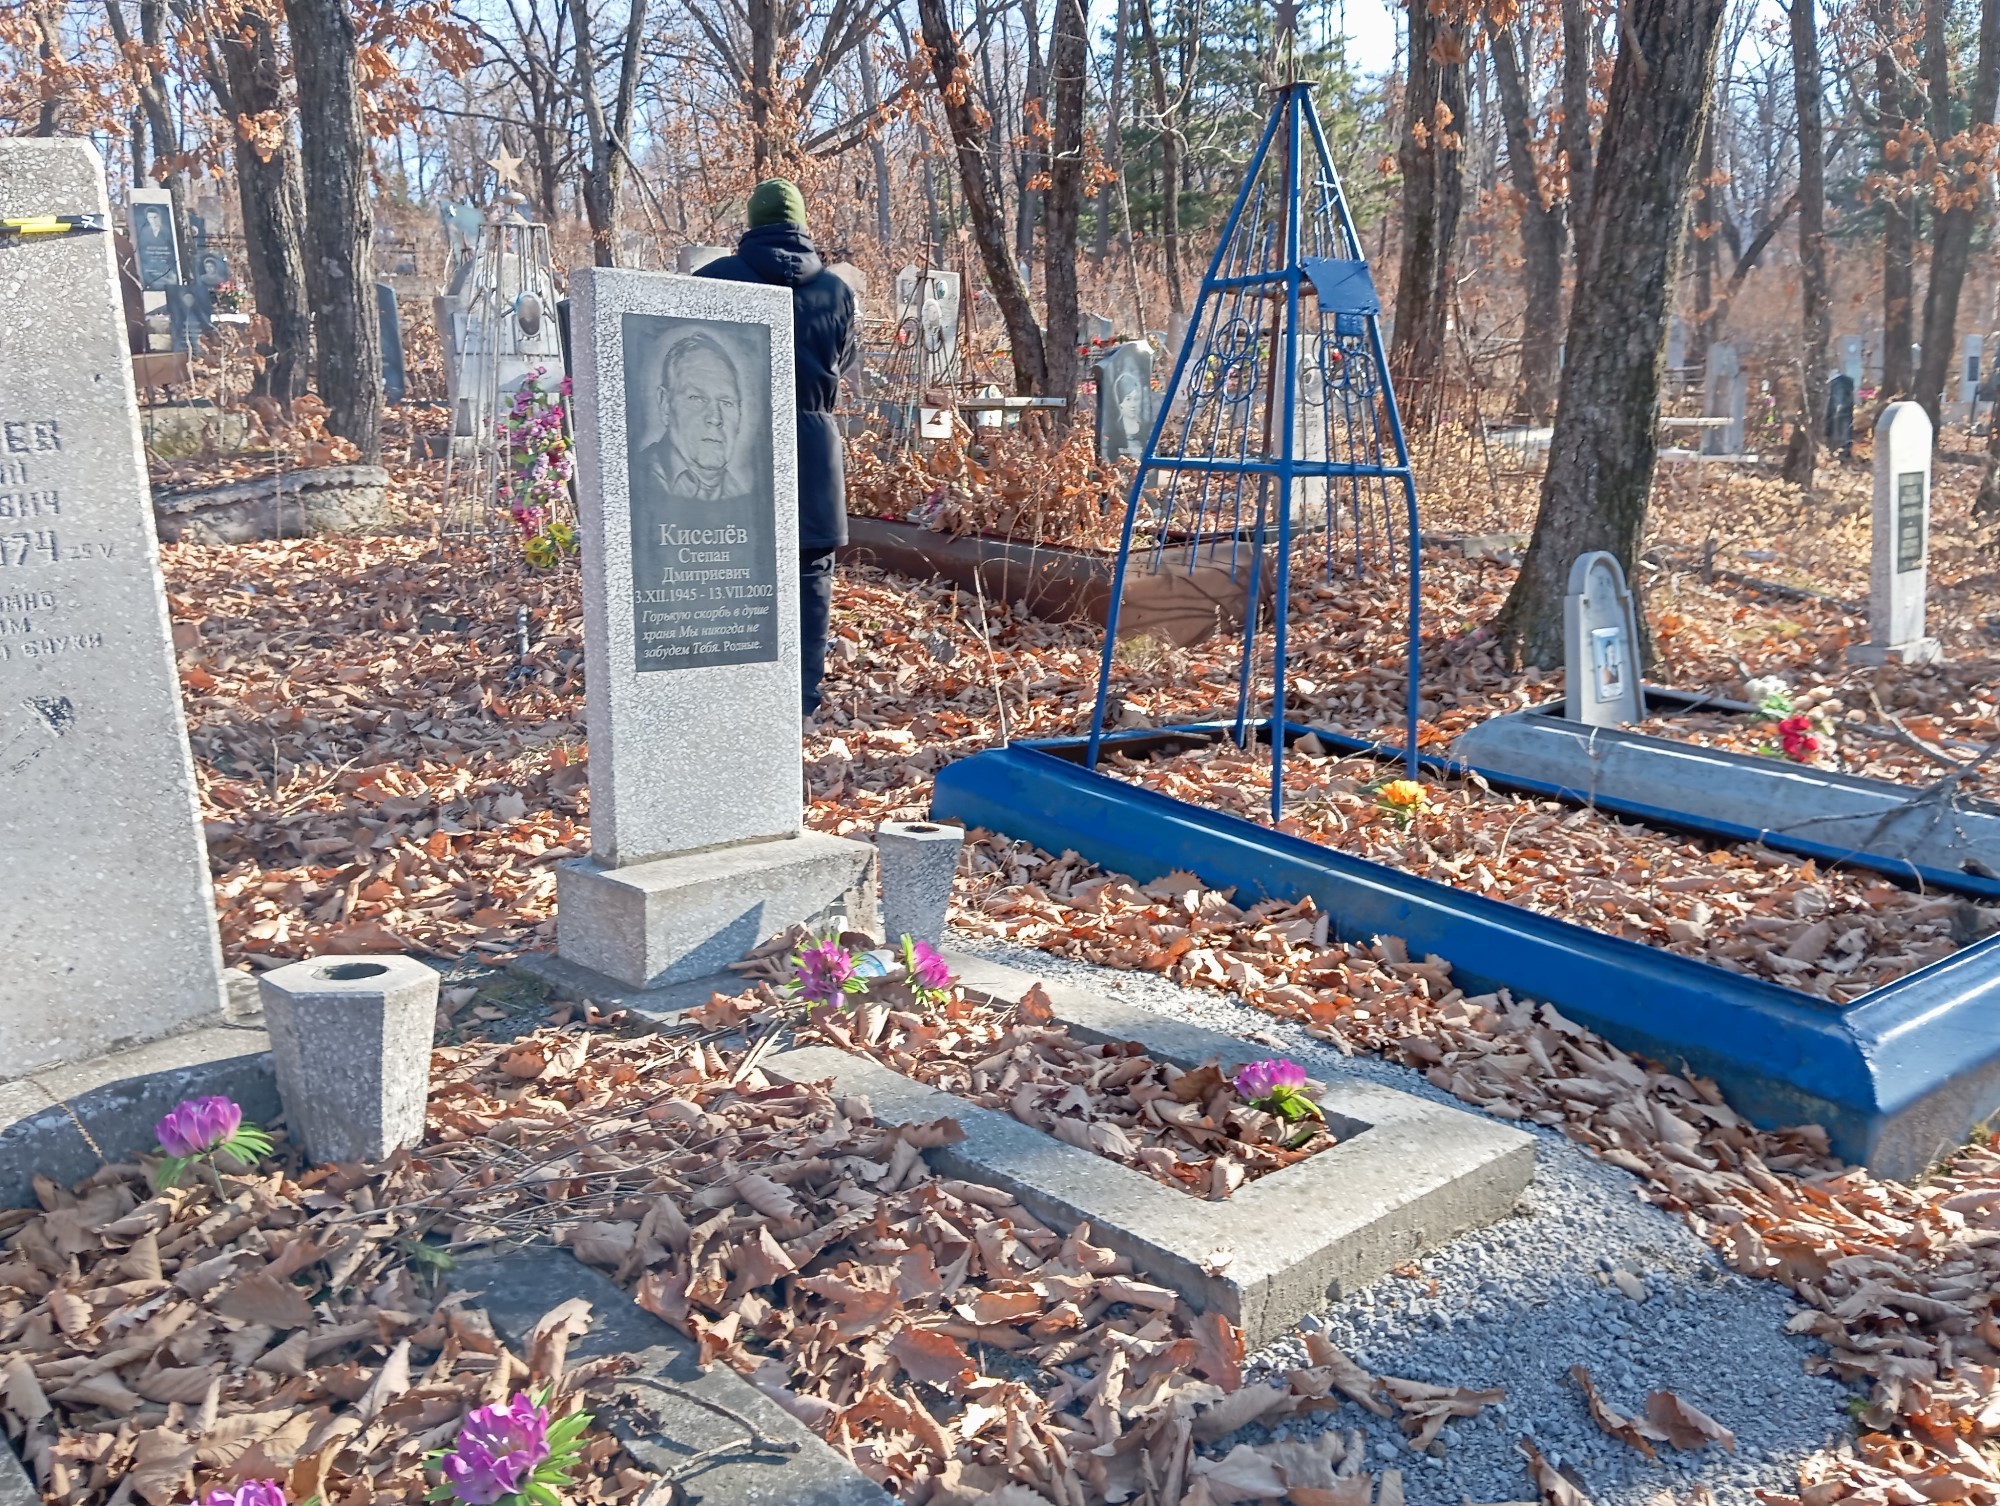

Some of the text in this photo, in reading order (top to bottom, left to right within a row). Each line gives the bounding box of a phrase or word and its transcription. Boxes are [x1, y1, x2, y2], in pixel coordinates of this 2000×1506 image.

[658, 523, 748, 546] Киселёв
[678, 547, 731, 563] Степан
[662, 567, 751, 585] Дмитриевич
[709, 584, 774, 600] 13.VII.2002
[641, 604, 770, 625] Горькую скорбь в душе
[642, 623, 760, 643] храня Мы никогда не
[644, 644, 690, 660] забудем
